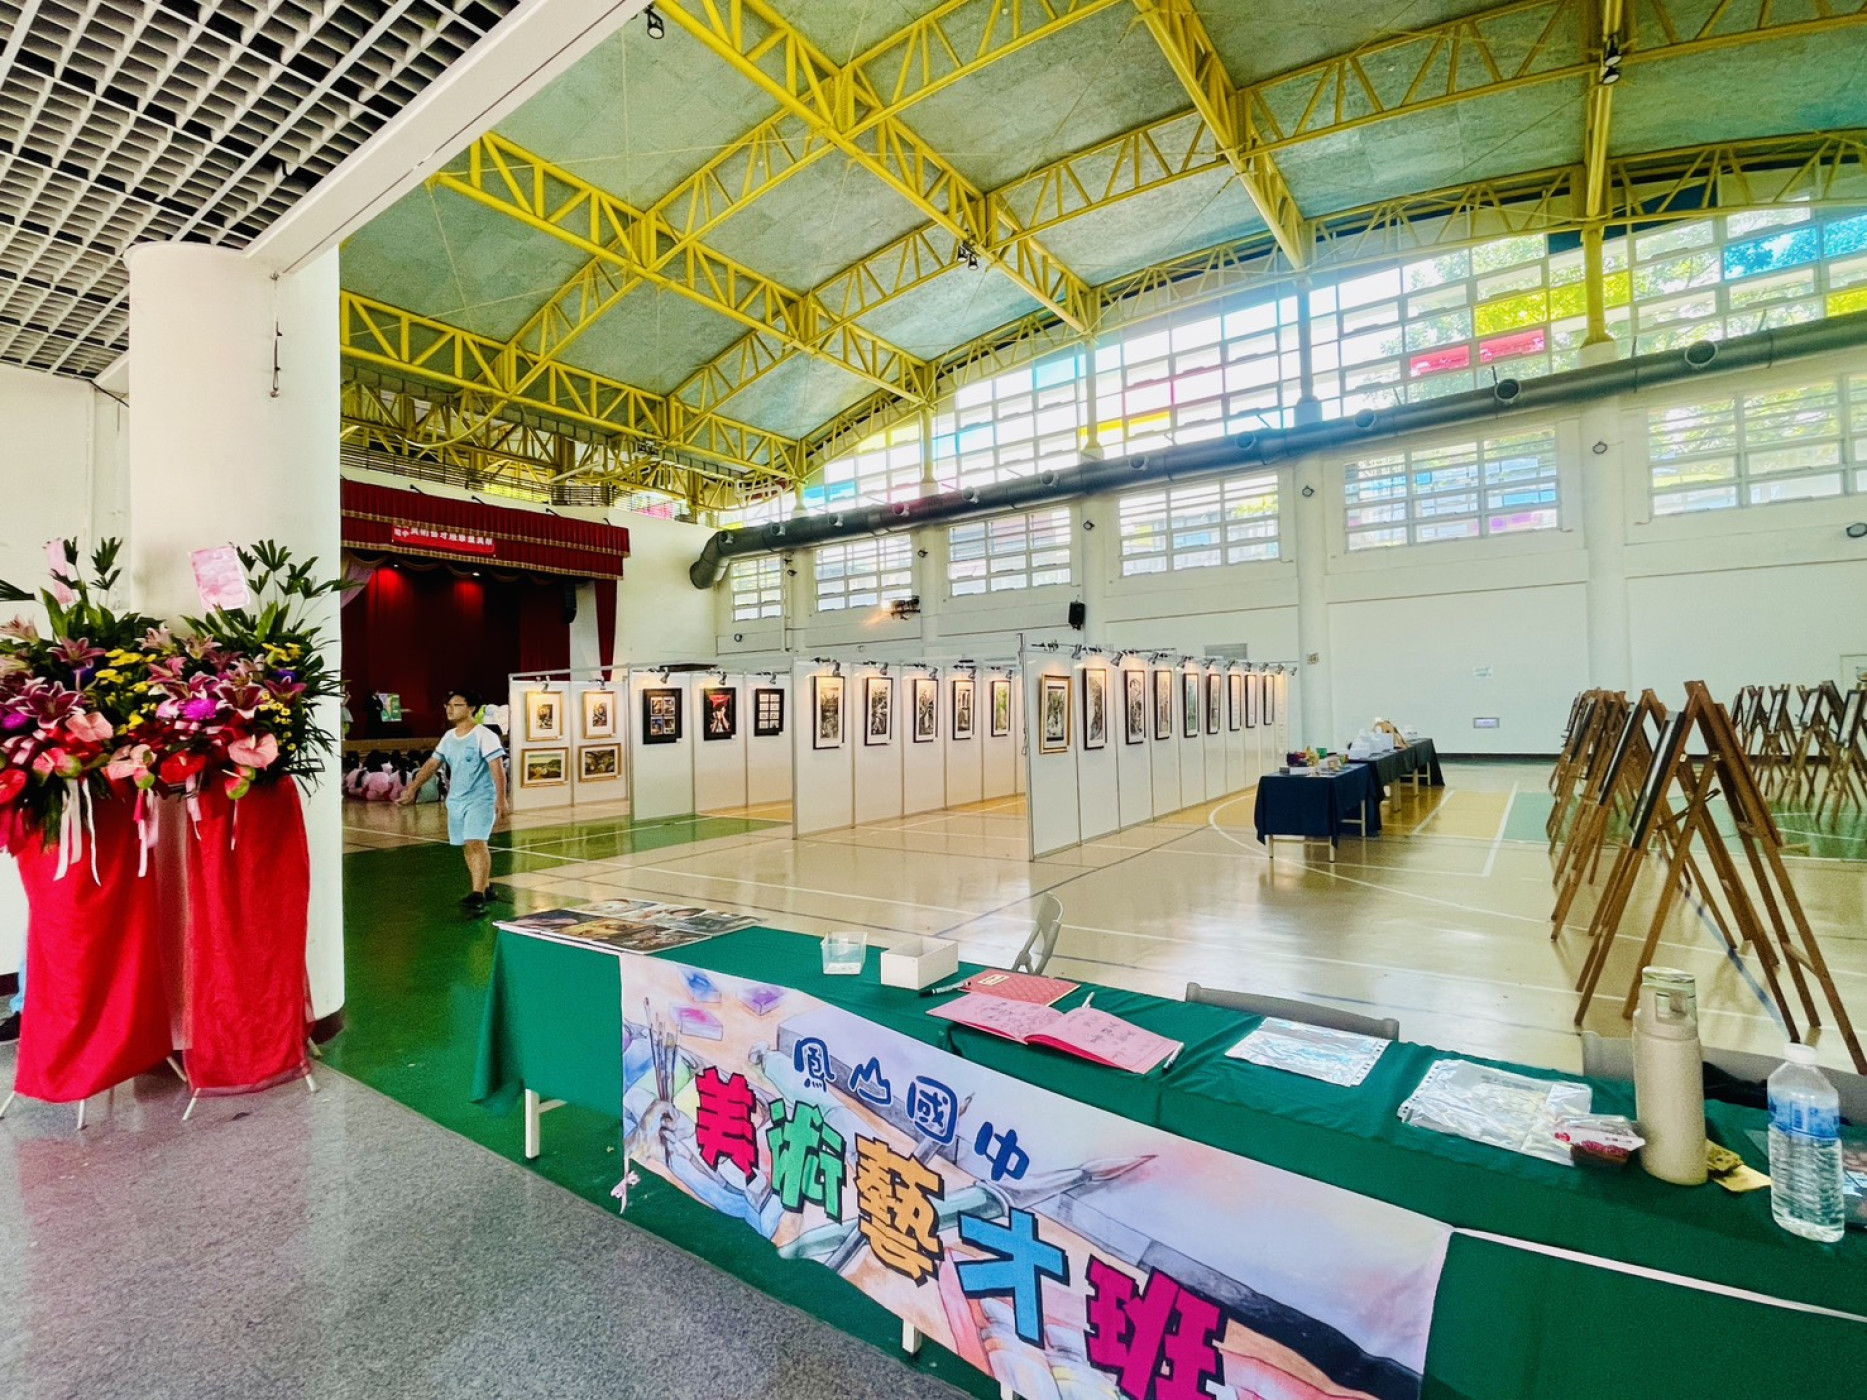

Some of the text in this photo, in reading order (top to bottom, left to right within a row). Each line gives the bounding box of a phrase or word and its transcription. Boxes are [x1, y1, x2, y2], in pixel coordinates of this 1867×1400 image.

[795, 1037, 1030, 1181] 鳳山國中
[695, 1066, 1228, 1400] 美術藝才班
